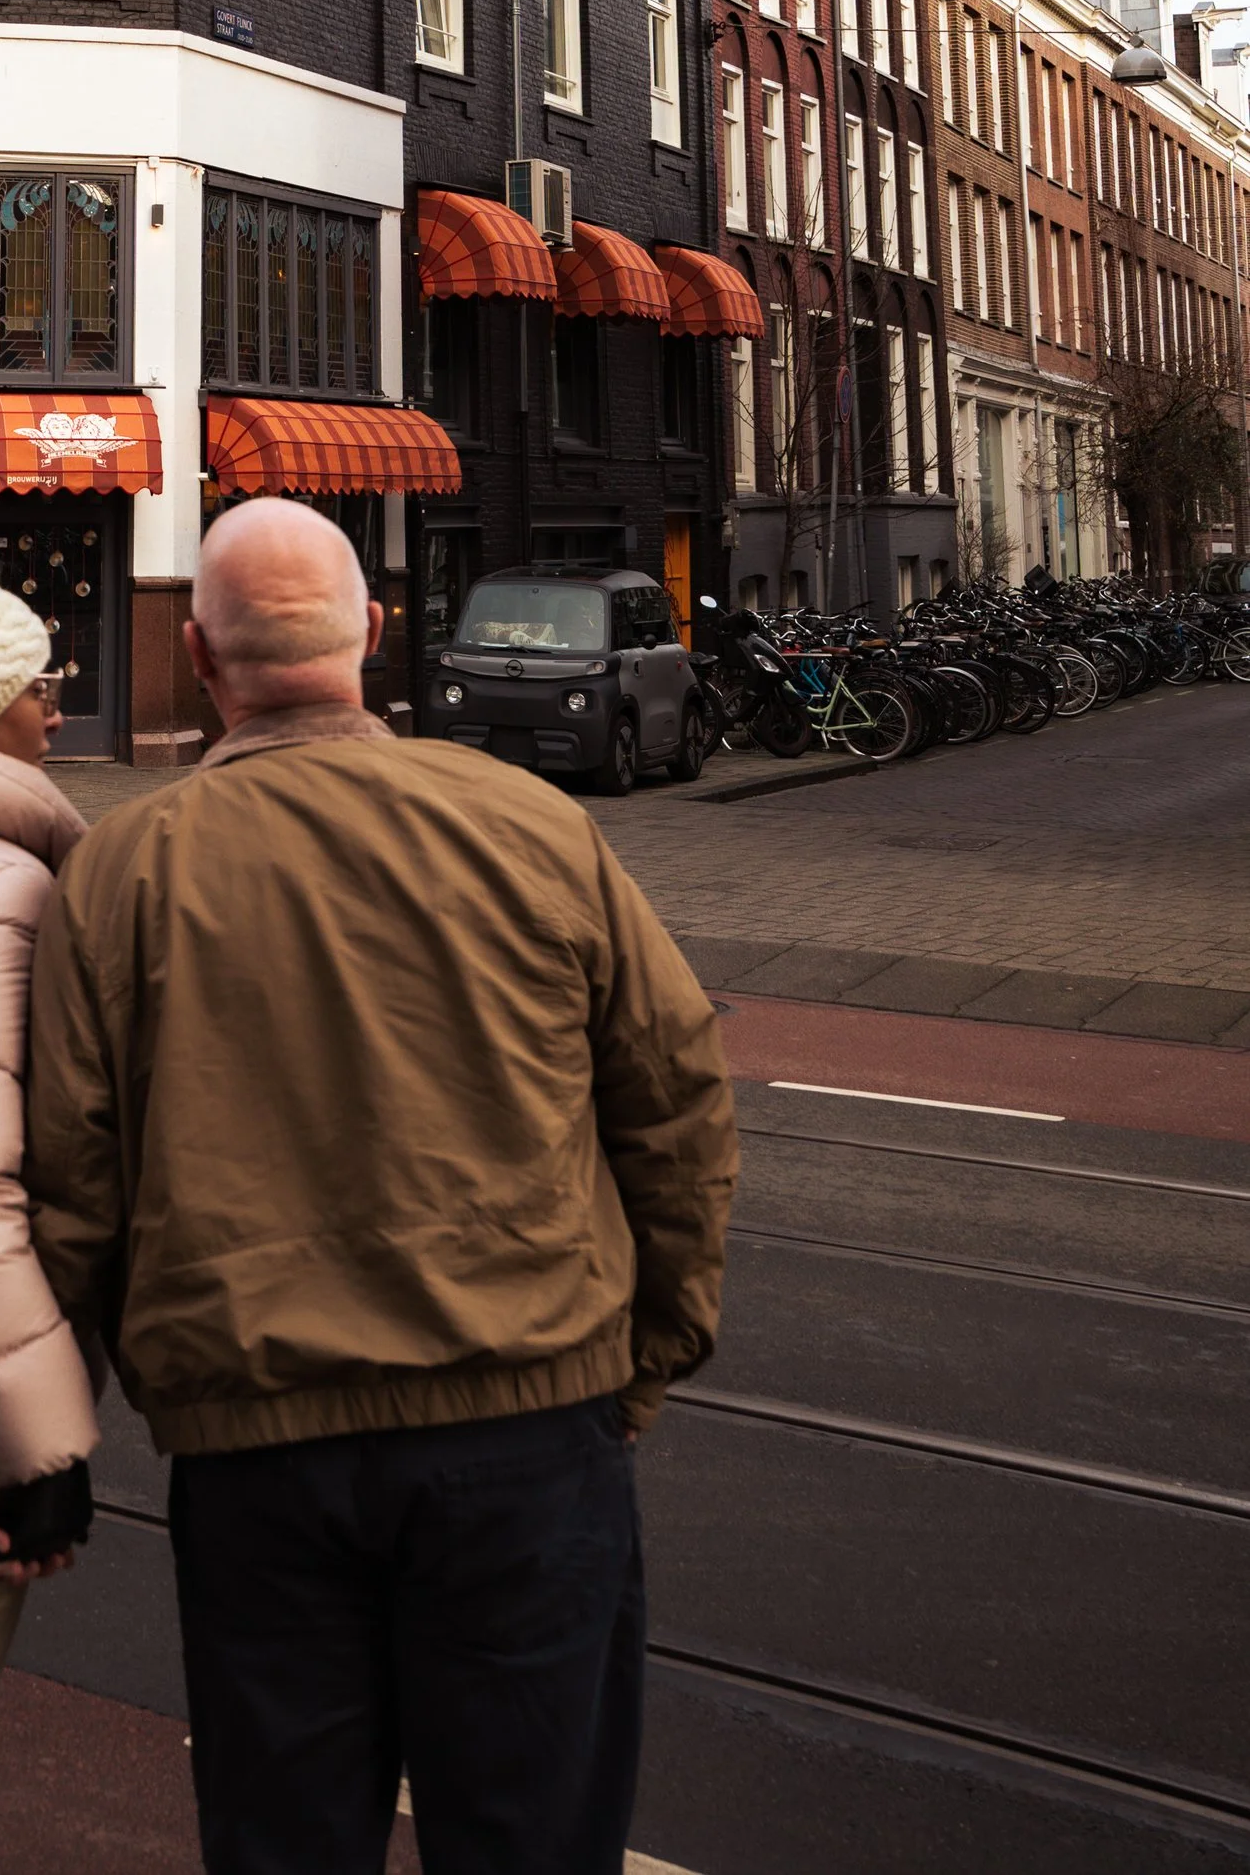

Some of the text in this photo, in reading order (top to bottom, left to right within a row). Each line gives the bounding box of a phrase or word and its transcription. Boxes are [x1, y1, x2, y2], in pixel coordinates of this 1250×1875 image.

[216, 10, 252, 31] GOVERT FLINCK
[217, 23, 234, 37] STRAAT
[7, 476, 45, 484] BROUWERIJ
